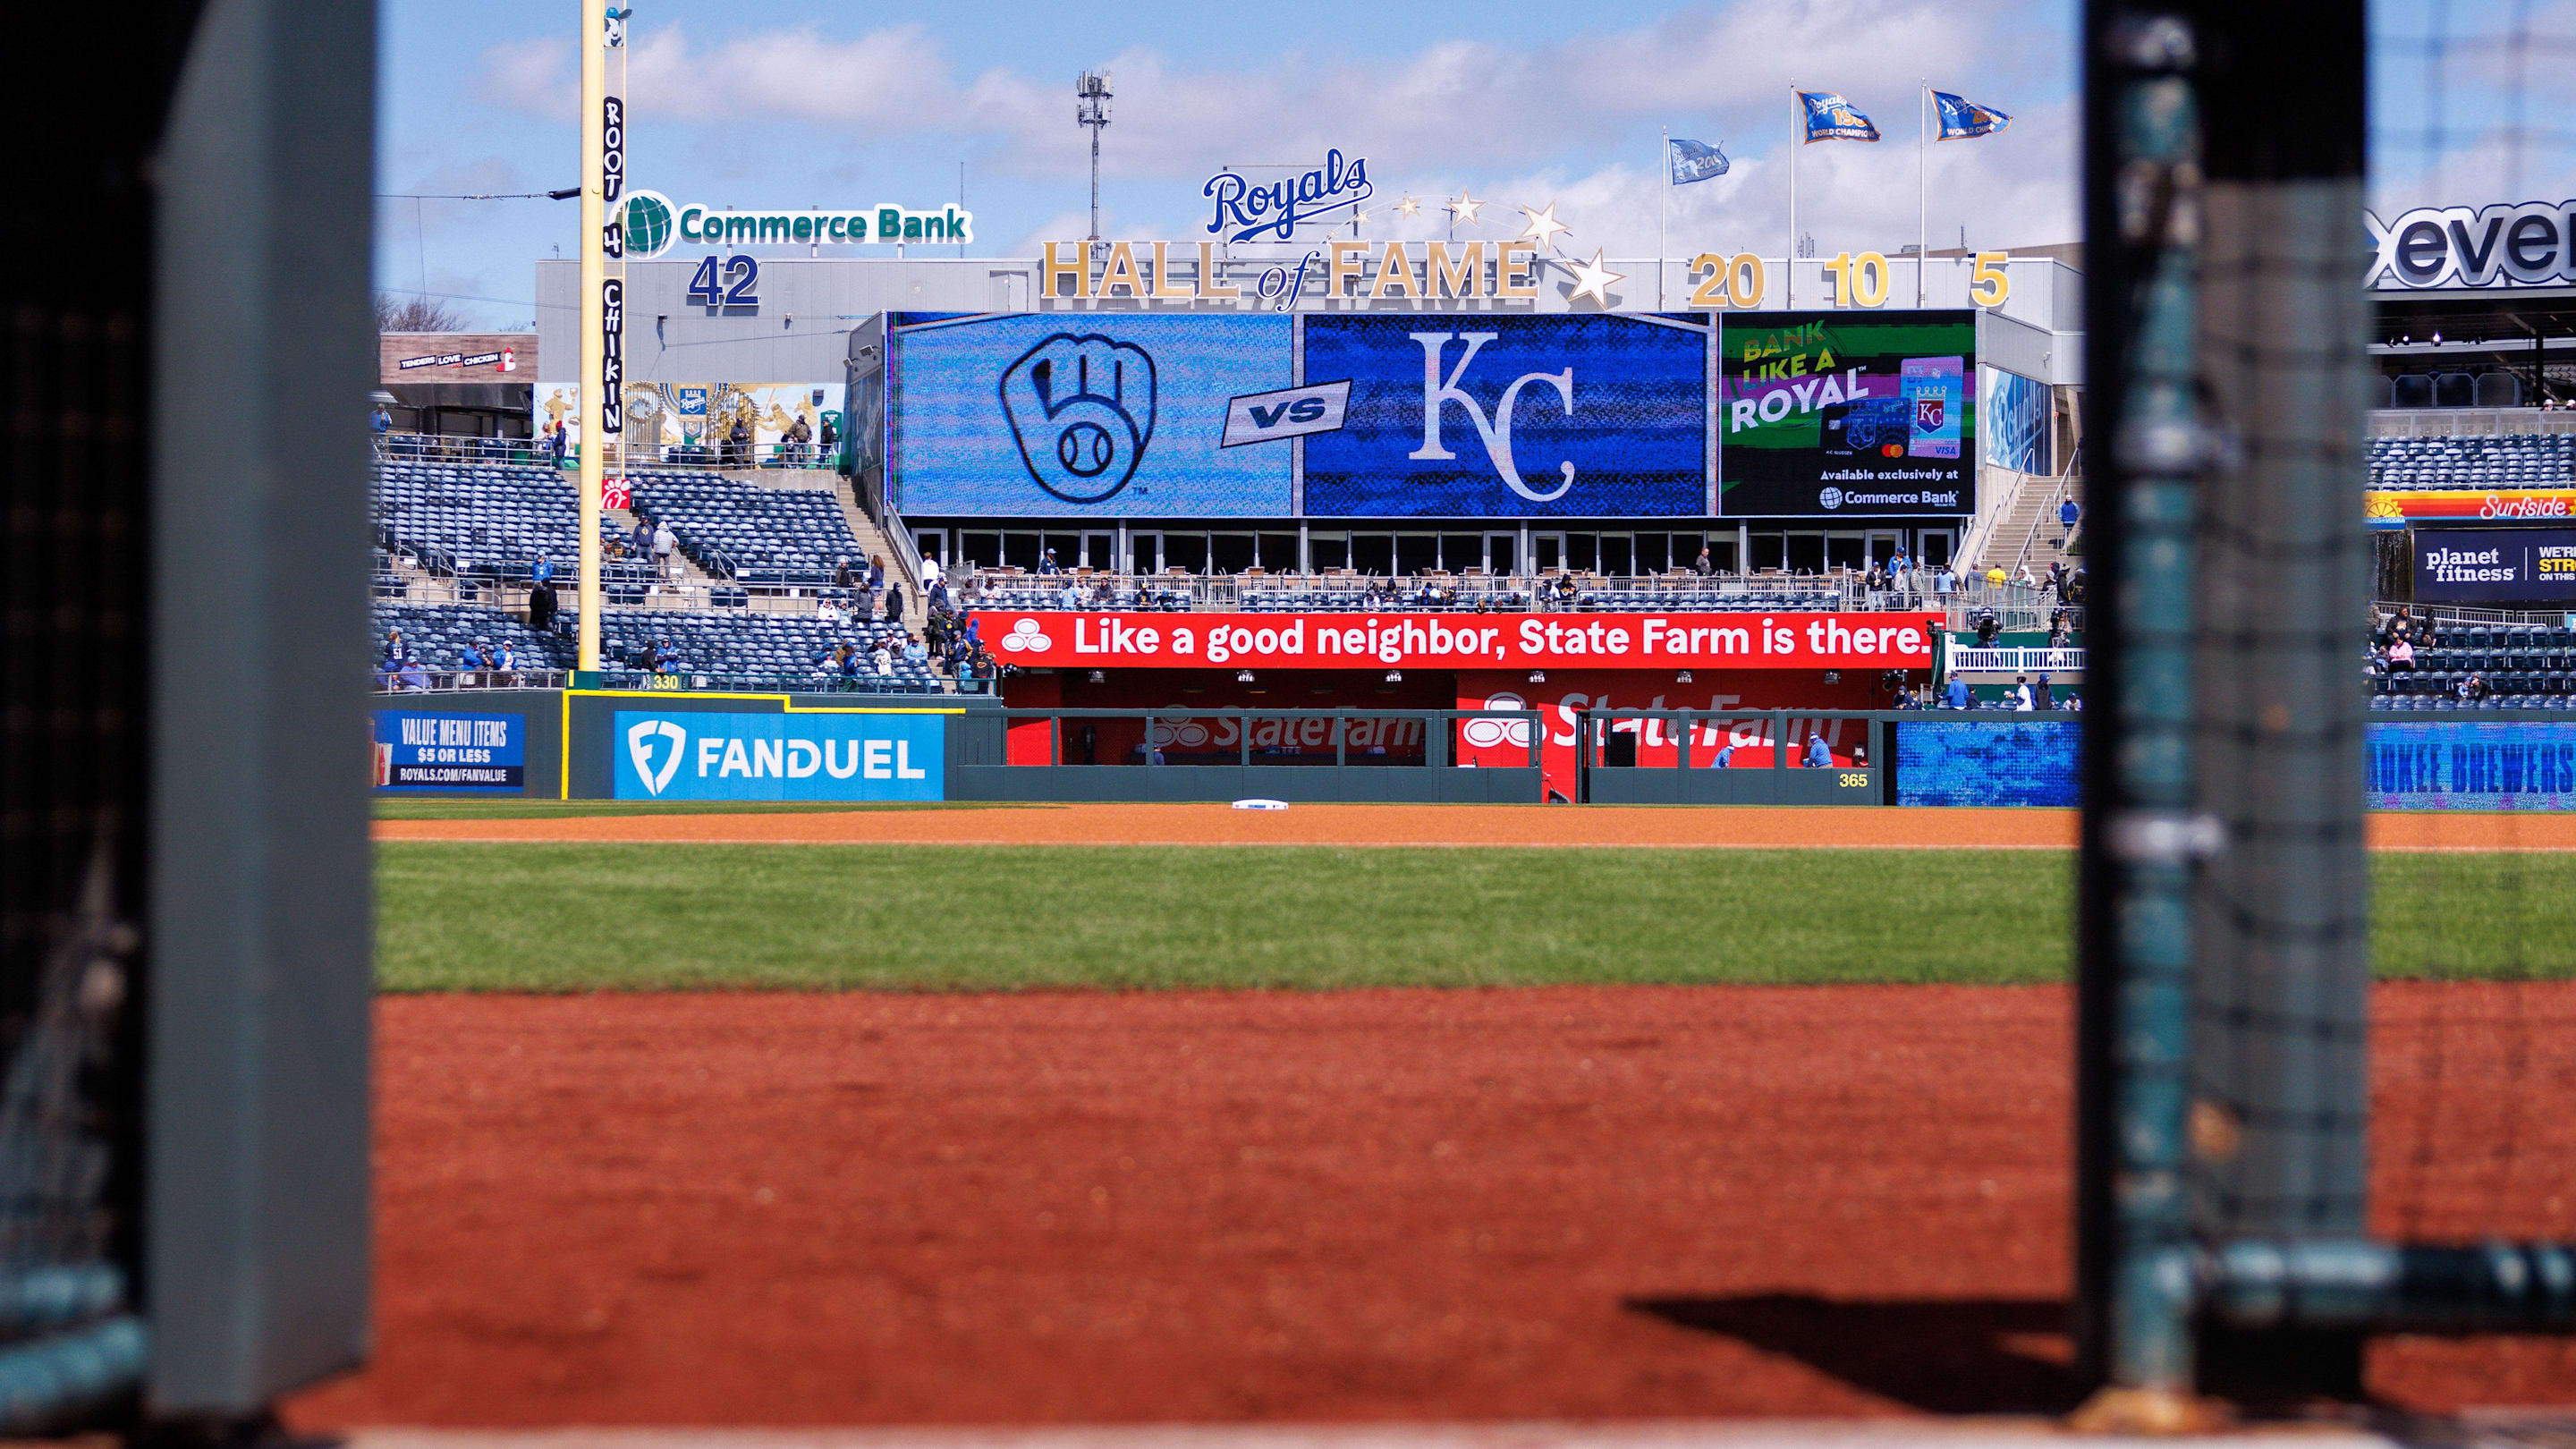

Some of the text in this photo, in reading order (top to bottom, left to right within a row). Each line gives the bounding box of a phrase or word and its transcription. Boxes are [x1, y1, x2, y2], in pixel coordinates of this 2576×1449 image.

[1811, 129, 1834, 137] WORLD
[604, 102, 622, 198] ROOT
[1203, 148, 1373, 243] Royals
[680, 208, 966, 239] Commerce Bank
[604, 228, 620, 253] 4
[2398, 214, 2576, 275] eve
[688, 254, 760, 307] 42
[1041, 240, 1540, 313] HALL of FAME
[1690, 251, 1766, 308] 20
[1824, 251, 1889, 308] 10
[1970, 251, 2010, 308] 5
[1743, 319, 1826, 363] BANK
[401, 355, 436, 369] TENDERS
[437, 354, 462, 365] LOVE
[463, 353, 499, 366] CHICKEN
[604, 285, 622, 428] CHIKIN
[1742, 347, 1836, 392] LIKE A
[1249, 397, 1326, 429] VS
[1408, 332, 1575, 502] KC
[1919, 402, 1942, 427] KC
[1935, 446, 1956, 455] VISA
[1820, 468, 1959, 481] Available exclusively at
[1844, 490, 1957, 504] Commerce Bank
[2479, 494, 2566, 520] Surfside
[2426, 547, 2499, 570] planet
[2538, 547, 2576, 558] WE'R
[2538, 558, 2576, 572] STR
[2436, 564, 2515, 581] fitness
[2538, 572, 2576, 580] ON THIS
[1075, 617, 1930, 664] Like a good neighbor, State Farm is there.
[654, 674, 679, 690] 330
[402, 718, 507, 748] VALUE MENU ITEMS
[418, 747, 491, 763] $5 OR LESS
[699, 738, 926, 780] FANDUEL
[2452, 743, 2574, 793] BREWERS
[401, 767, 507, 782] ROYALS.COM/FANVALUE
[1839, 773, 1868, 788] 365
